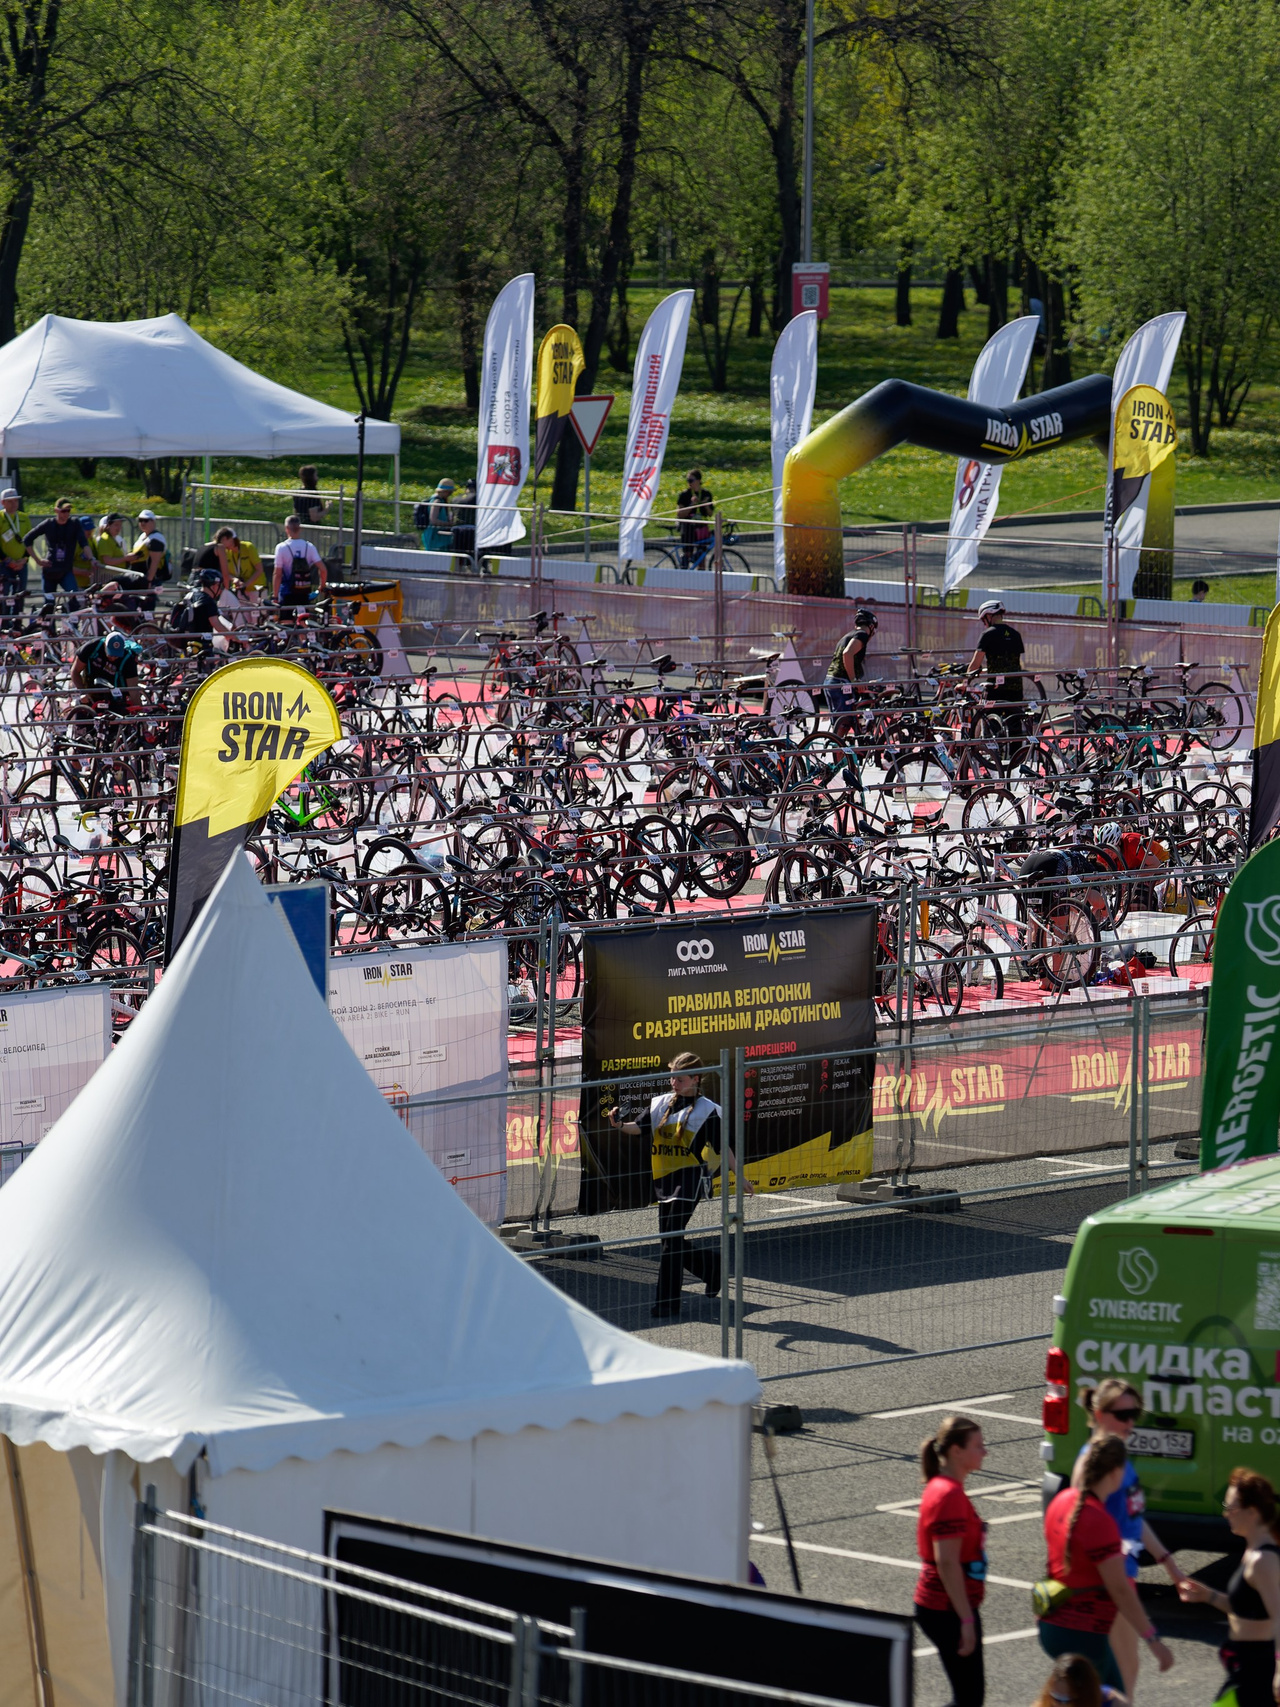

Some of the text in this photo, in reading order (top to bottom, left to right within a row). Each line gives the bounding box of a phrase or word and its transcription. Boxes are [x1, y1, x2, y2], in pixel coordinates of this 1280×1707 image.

[551, 362, 573, 386] STAR
[503, 390, 512, 435] спорта
[1132, 399, 1164, 419] IRON
[646, 412, 667, 460] СПОРТ
[984, 412, 1063, 448] IRON STAR
[1129, 418, 1176, 444] STAR
[222, 690, 283, 722] IRON
[218, 722, 311, 763] STAR
[742, 930, 806, 952] IRON STAR
[363, 963, 413, 980] IRON STAR
[667, 963, 728, 977] ЛИГА ТРИАТЛОНА
[349, 1004, 368, 1014] ЗОНЫ
[377, 999, 418, 1010] ВЕЛОСИПЕД
[425, 996, 436, 1005] БЕГ
[667, 982, 812, 1014] ПРАВИЛА ВЕЛОГОНКИ
[347, 1013, 365, 1022] AREA
[374, 1010, 388, 1019] BIKE
[395, 1008, 410, 1016] RUN
[633, 1001, 842, 1040] С РАЗРЕШЕННЫМ ДРАФТИНГОМ
[3, 1043, 46, 1054] ВЕЛОСИПЕД
[744, 1041, 797, 1057] ЗАПРЕЩЕНО
[601, 1055, 661, 1072] РАЗРЕШЕНО
[833, 1058, 850, 1066] ЛЕЖАК
[1070, 1042, 1191, 1090] IRON STAR
[759, 1083, 809, 1095] ЭЛЕКТРОДВИГАТЕЛИ
[874, 1063, 1005, 1113] IRON STAR
[786, 1096, 807, 1104] КОЛЕСА
[1089, 1298, 1183, 1324] SYNERGETIC
[1074, 1340, 1249, 1381] скидка
[1163, 1432, 1188, 1449] 152
[1222, 1426, 1253, 1443] на
